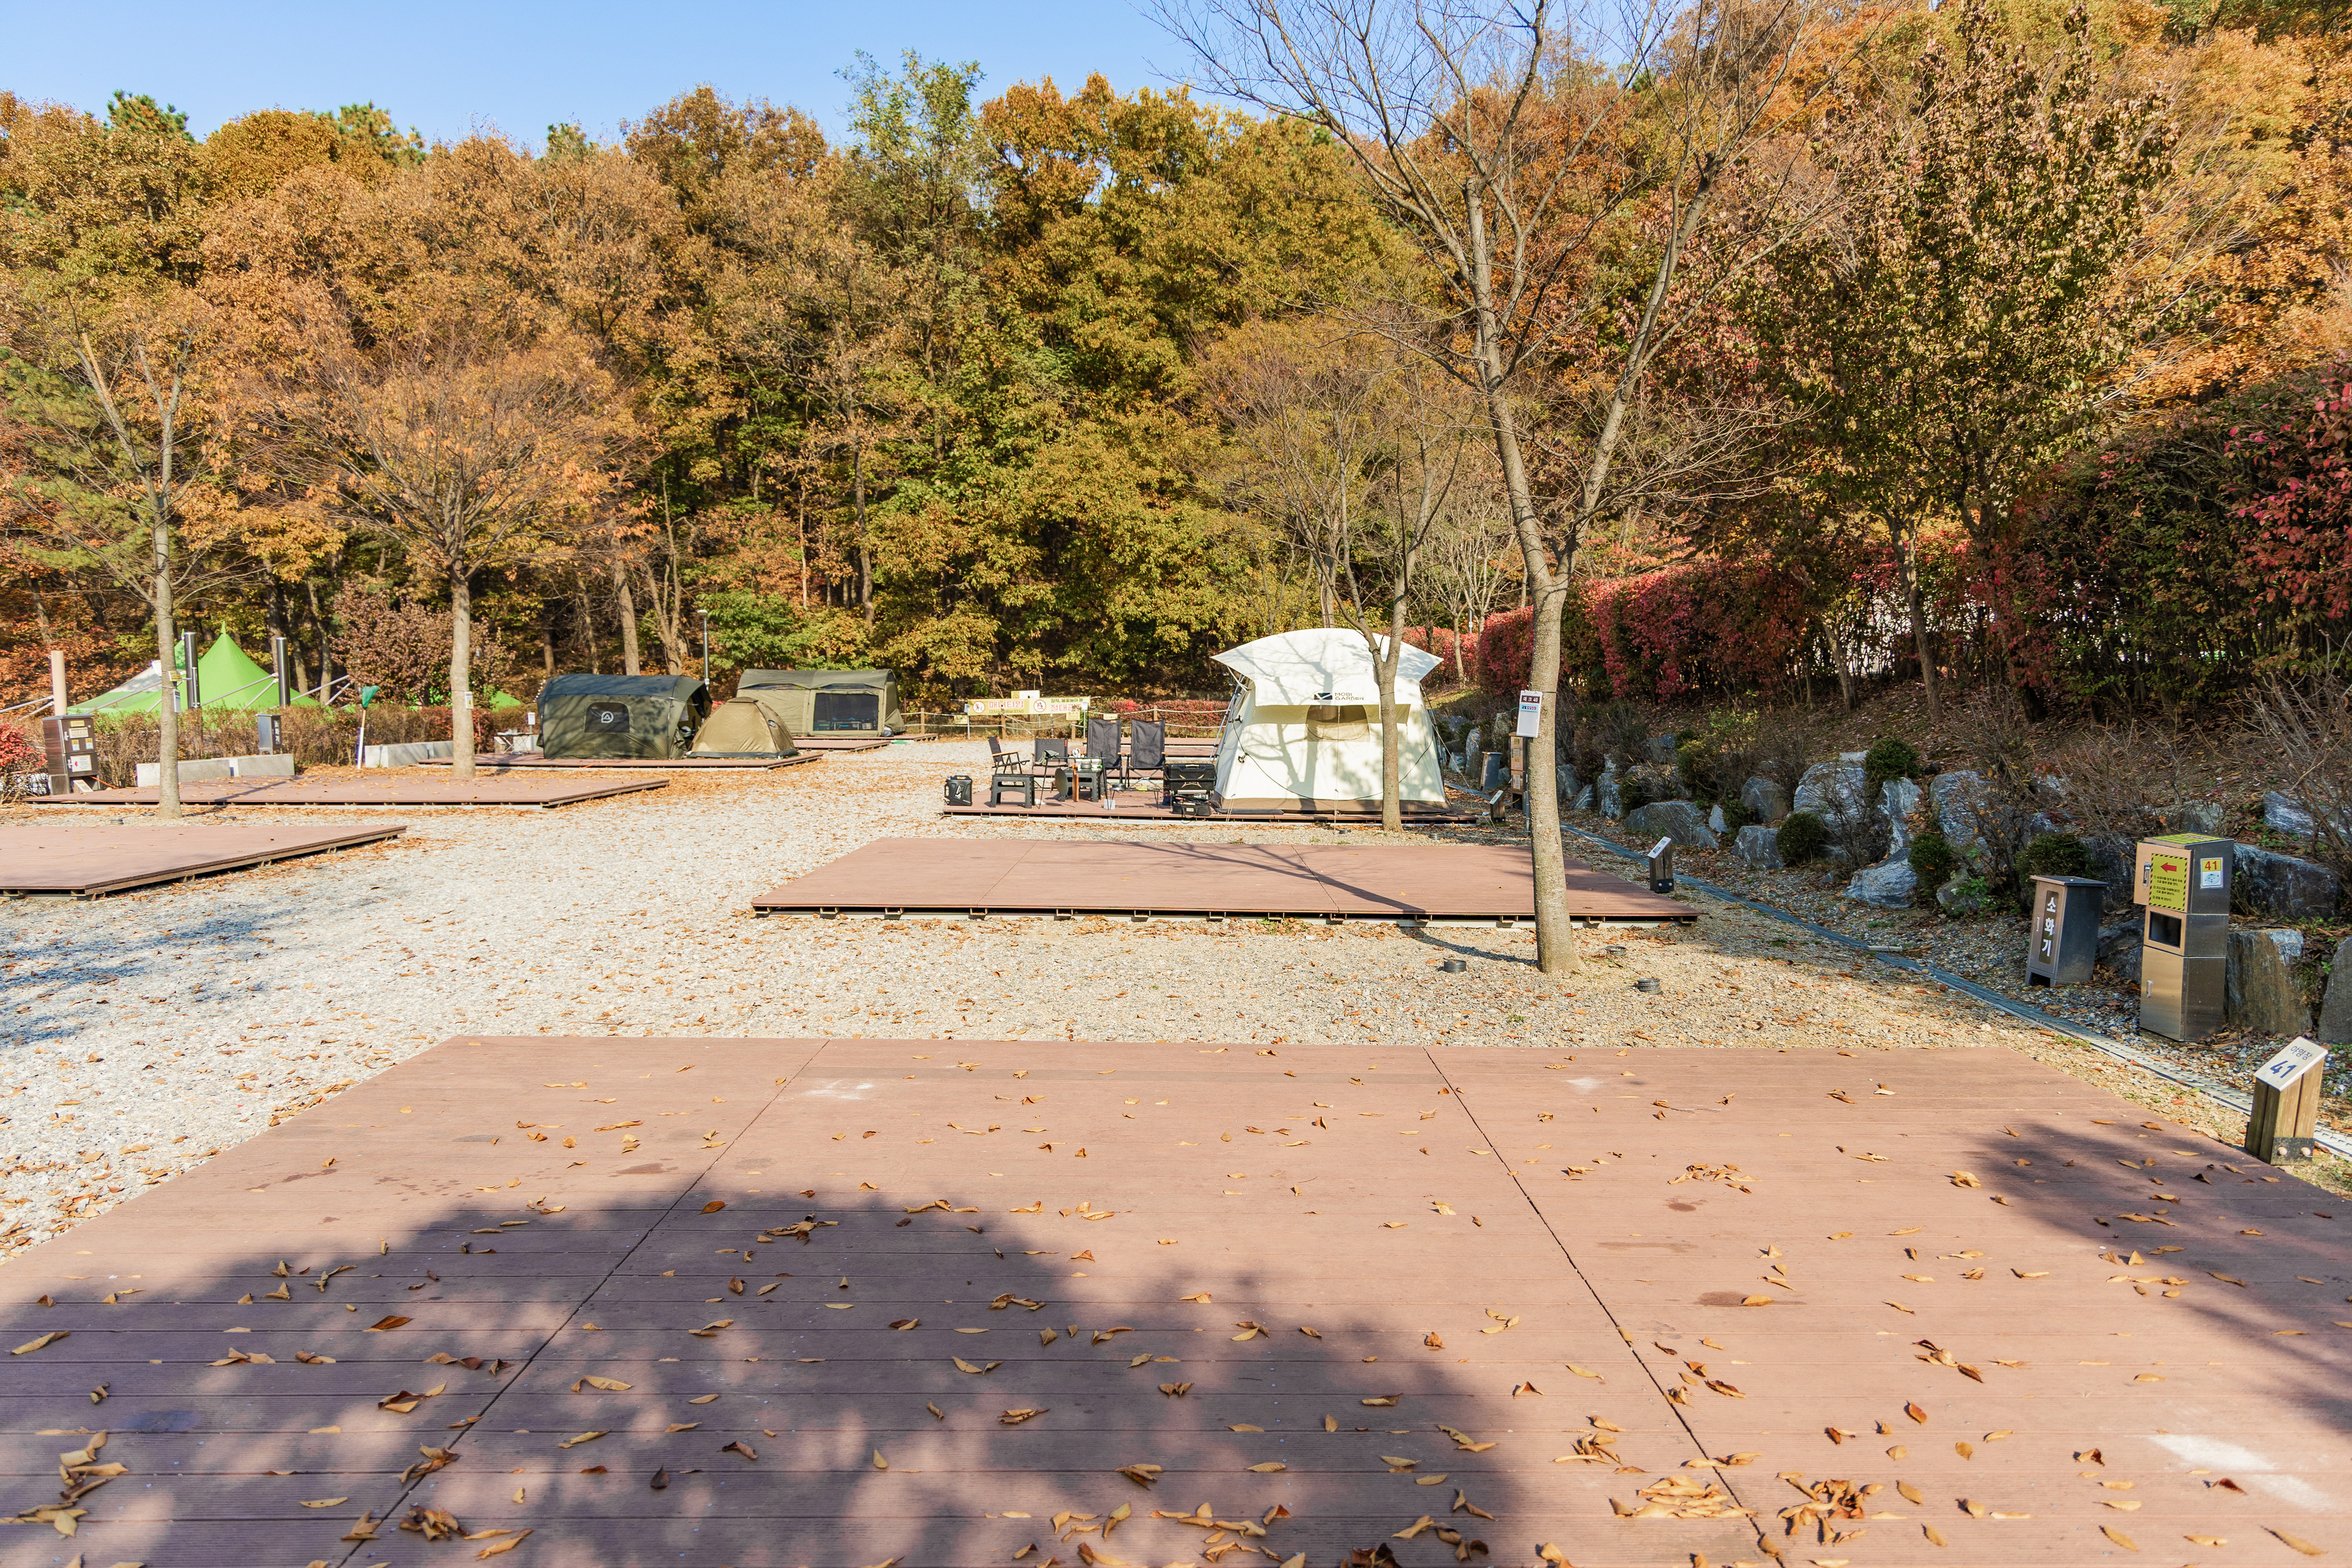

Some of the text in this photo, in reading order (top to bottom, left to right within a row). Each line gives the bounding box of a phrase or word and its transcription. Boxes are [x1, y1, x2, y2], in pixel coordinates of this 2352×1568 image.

[2205, 861, 2217, 870] 41
[2041, 897, 2056, 957] 소화기
[2290, 1046, 2313, 1060] 야영장
[2269, 1060, 2297, 1079] 41
